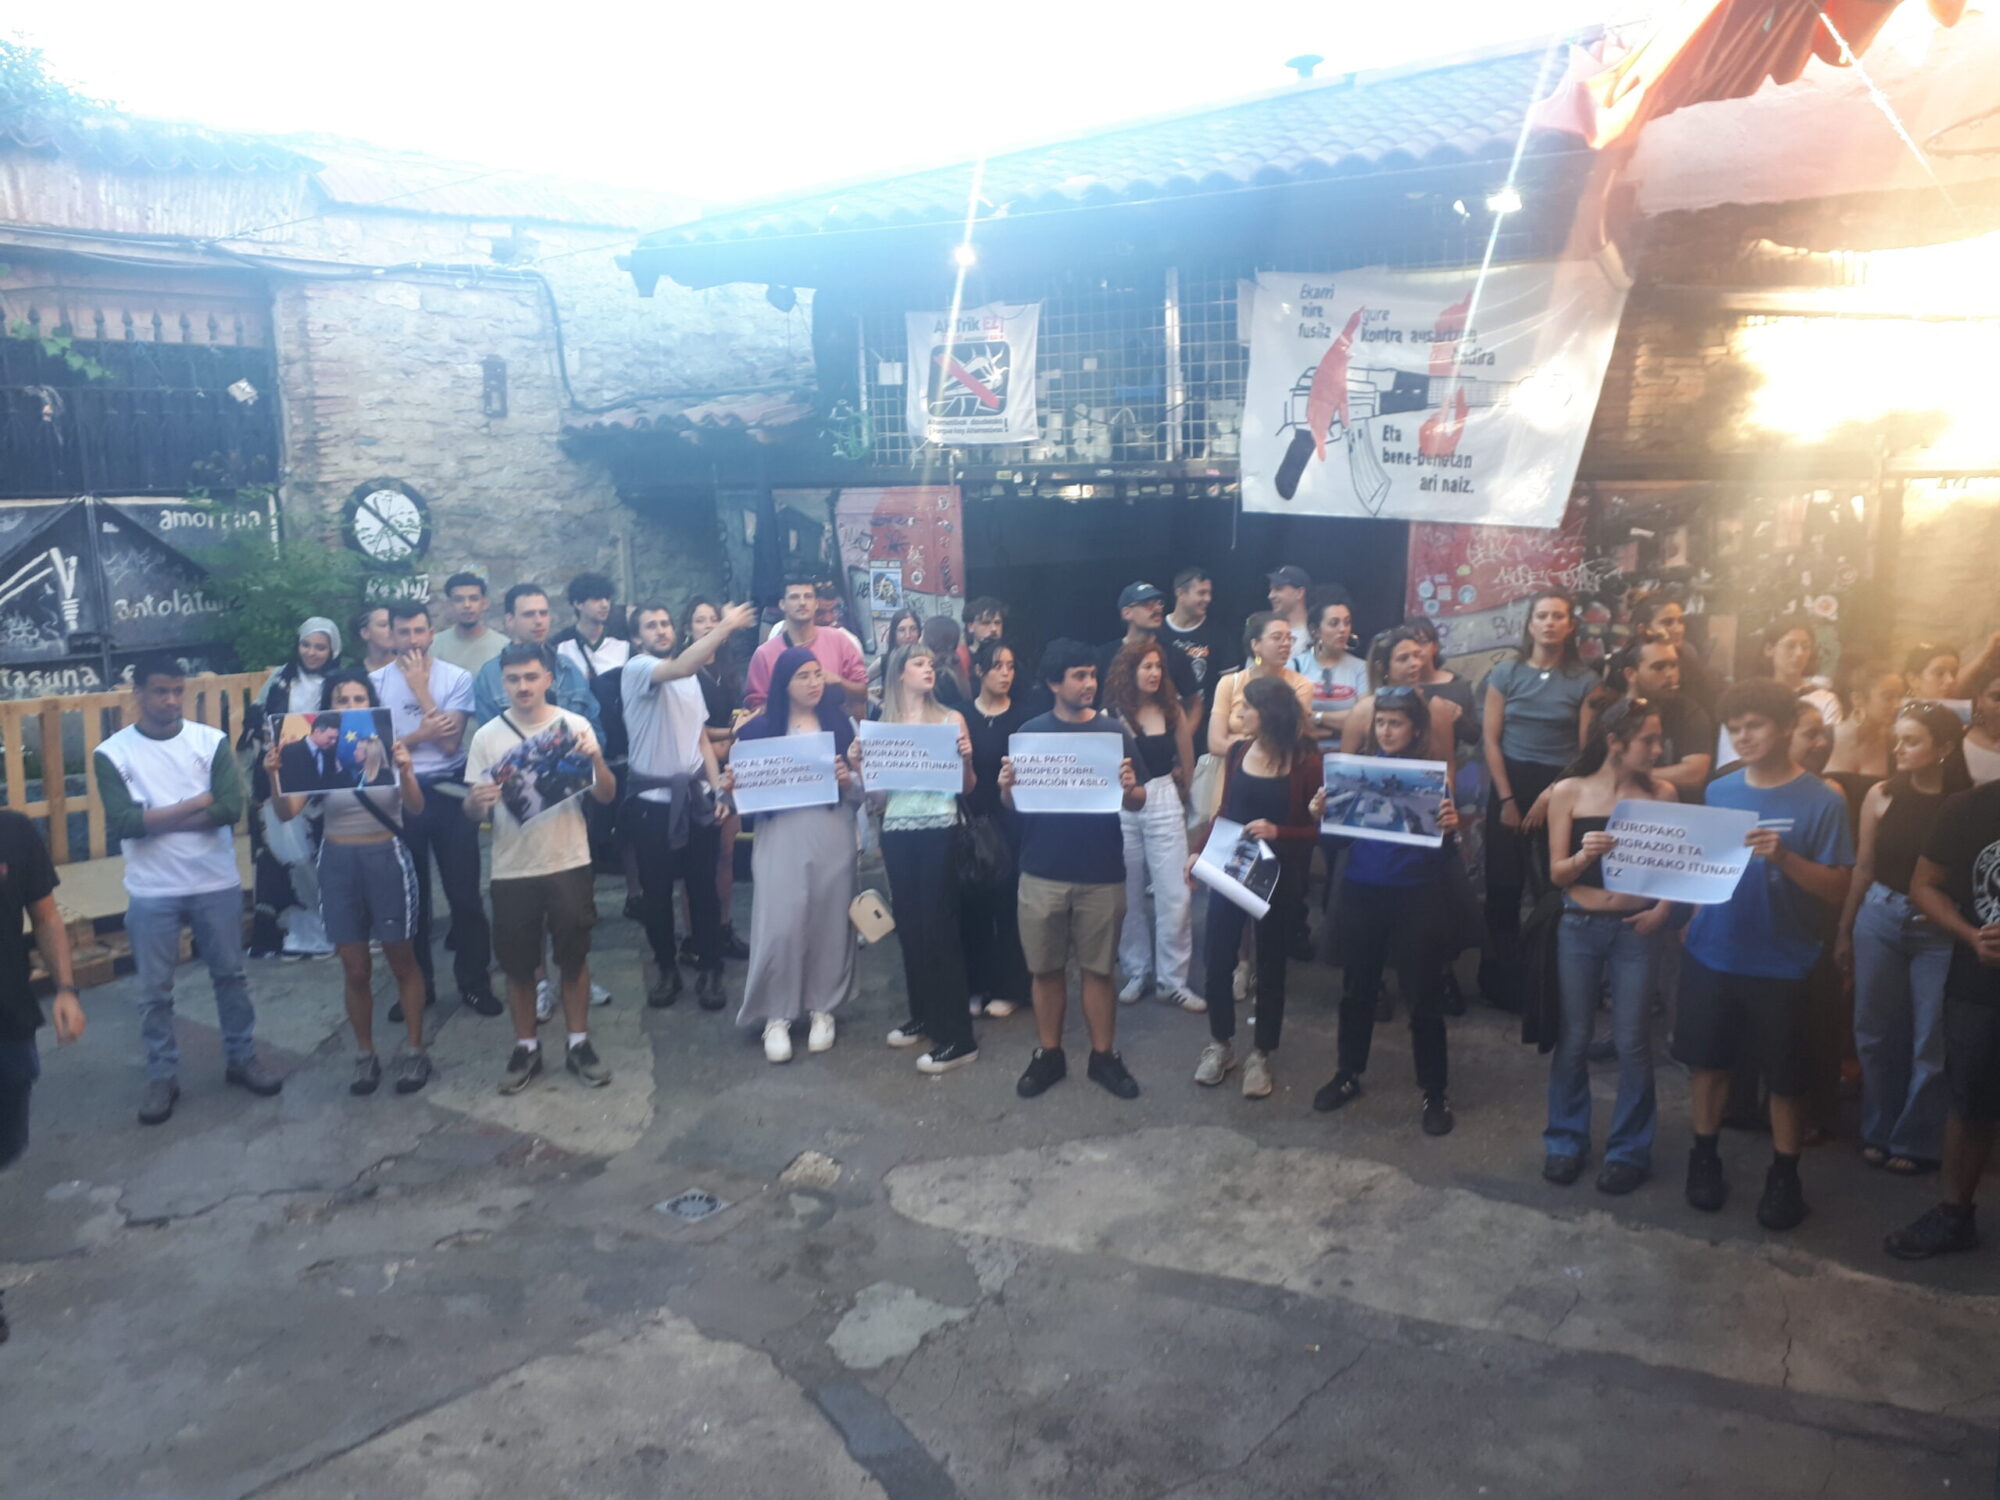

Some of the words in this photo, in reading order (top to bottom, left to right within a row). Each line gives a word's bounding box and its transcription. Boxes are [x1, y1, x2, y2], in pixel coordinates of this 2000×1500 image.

[1302, 301, 1323, 318] nire
[1362, 309, 1390, 325] gure
[1360, 326, 1403, 343] kontra
[1382, 425, 1402, 441] Eta
[1419, 474, 1437, 492] ari
[1441, 476, 1474, 493] naiz.
[911, 750, 929, 758] ETA
[1013, 755, 1028, 763] NO
[1029, 755, 1042, 763] AL
[1045, 755, 1077, 764] PACTO
[734, 760, 747, 768] NO
[750, 759, 761, 767] AL
[764, 756, 794, 765] PACTO
[781, 765, 810, 775] SOBRE
[1014, 766, 1060, 775] EUROPEO
[1063, 766, 1095, 775] SOBRE
[1079, 778, 1109, 786] ASILO
[1611, 821, 1687, 839] EUROPAKO
[1677, 845, 1703, 857] ETA
[1607, 852, 1686, 870] ASILORAKO
[1687, 862, 1741, 876] ITUNARI
[1605, 866, 1624, 877] EZ
